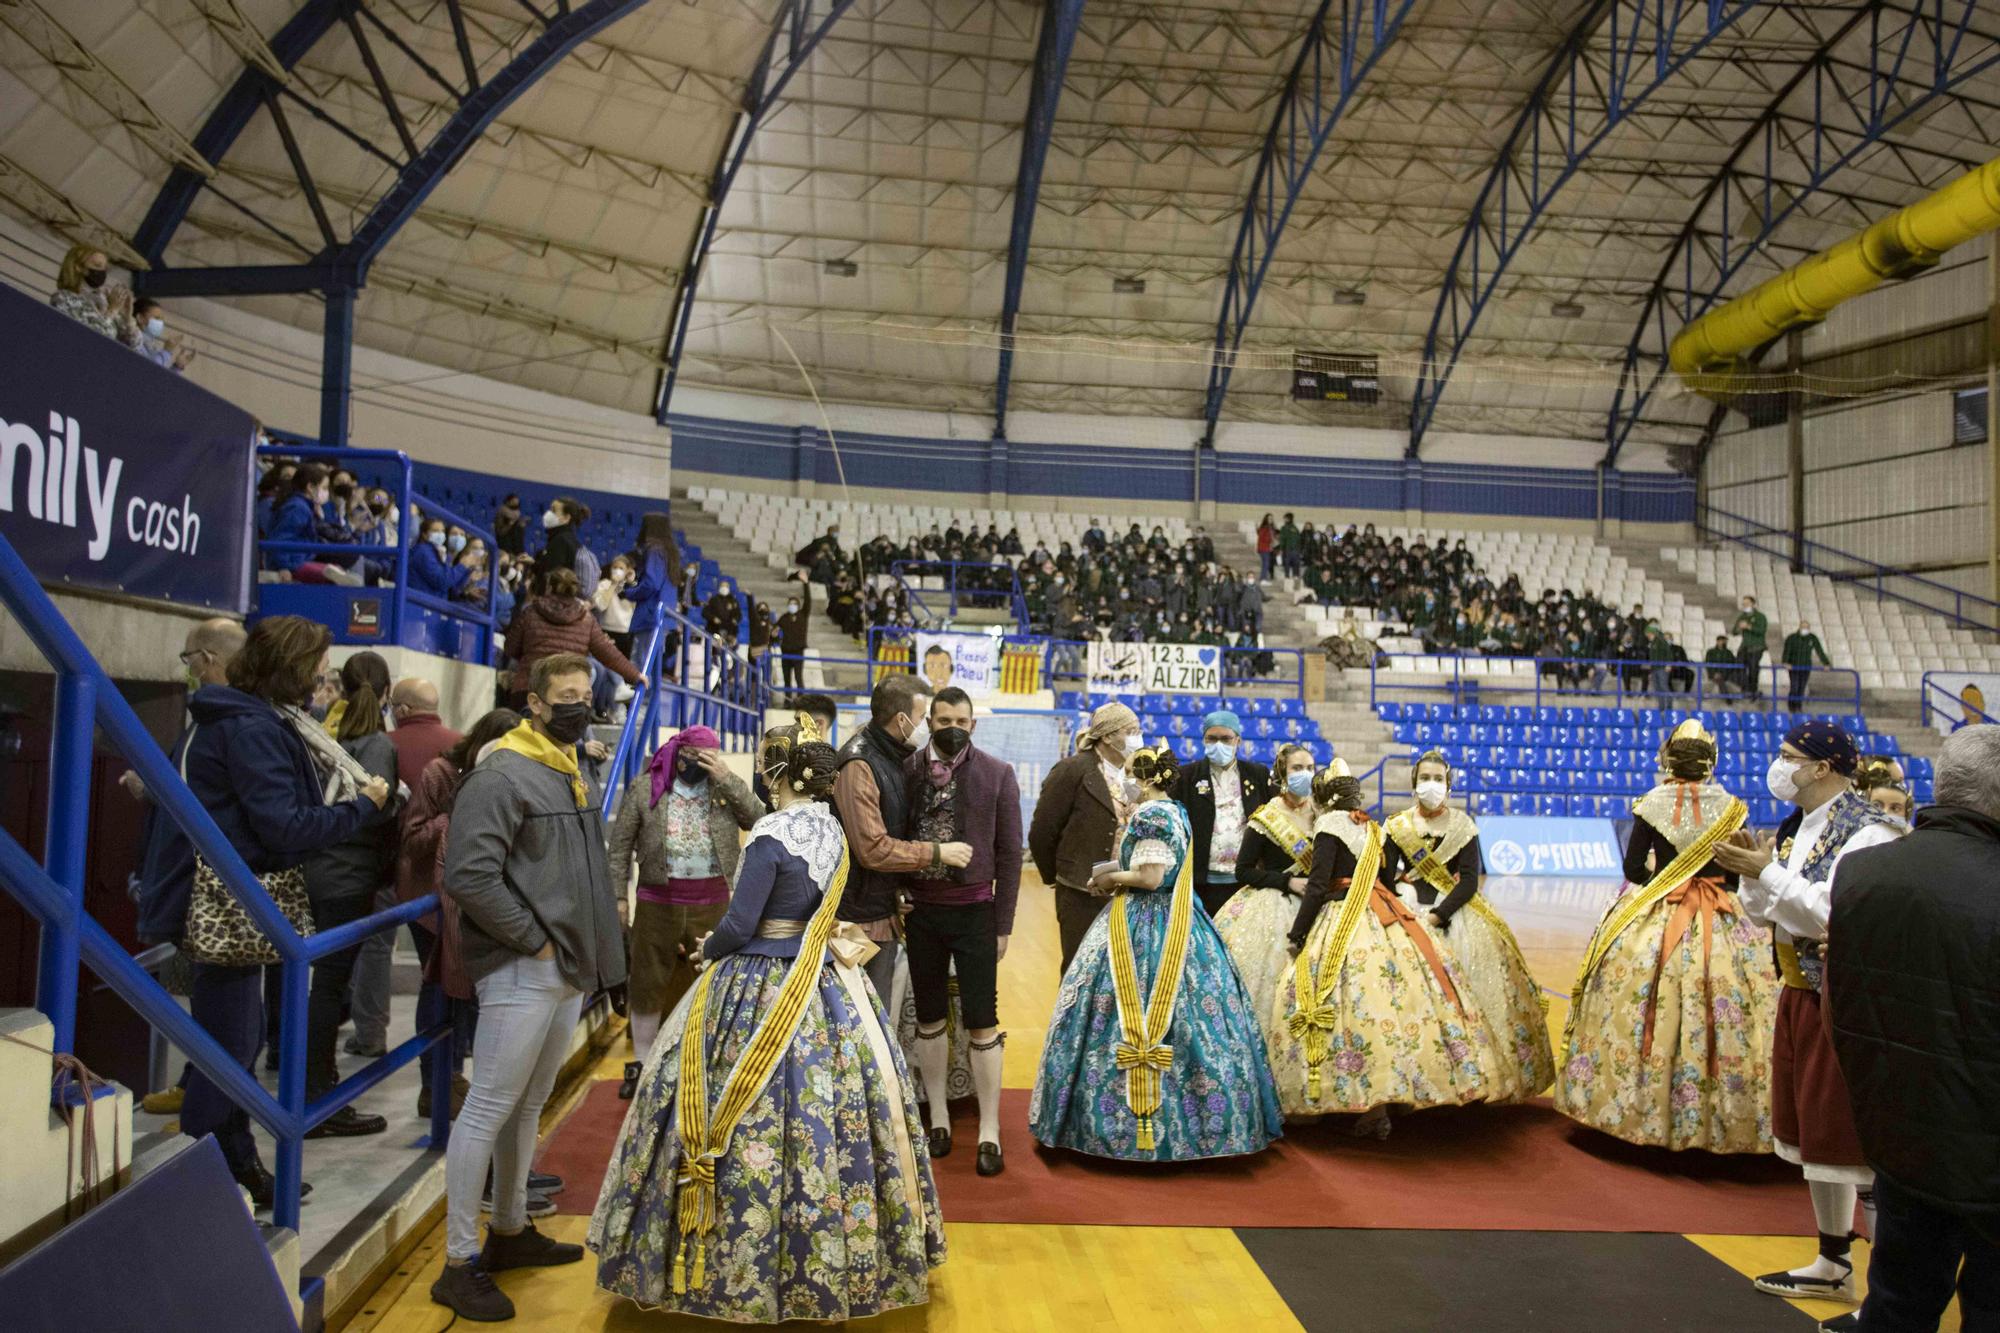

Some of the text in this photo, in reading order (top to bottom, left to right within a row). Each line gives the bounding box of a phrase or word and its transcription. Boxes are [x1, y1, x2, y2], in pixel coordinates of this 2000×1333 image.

[127, 494, 200, 556] cash
[1152, 666, 1218, 689] ALZIRA
[1550, 841, 1618, 870] FUTSAL
